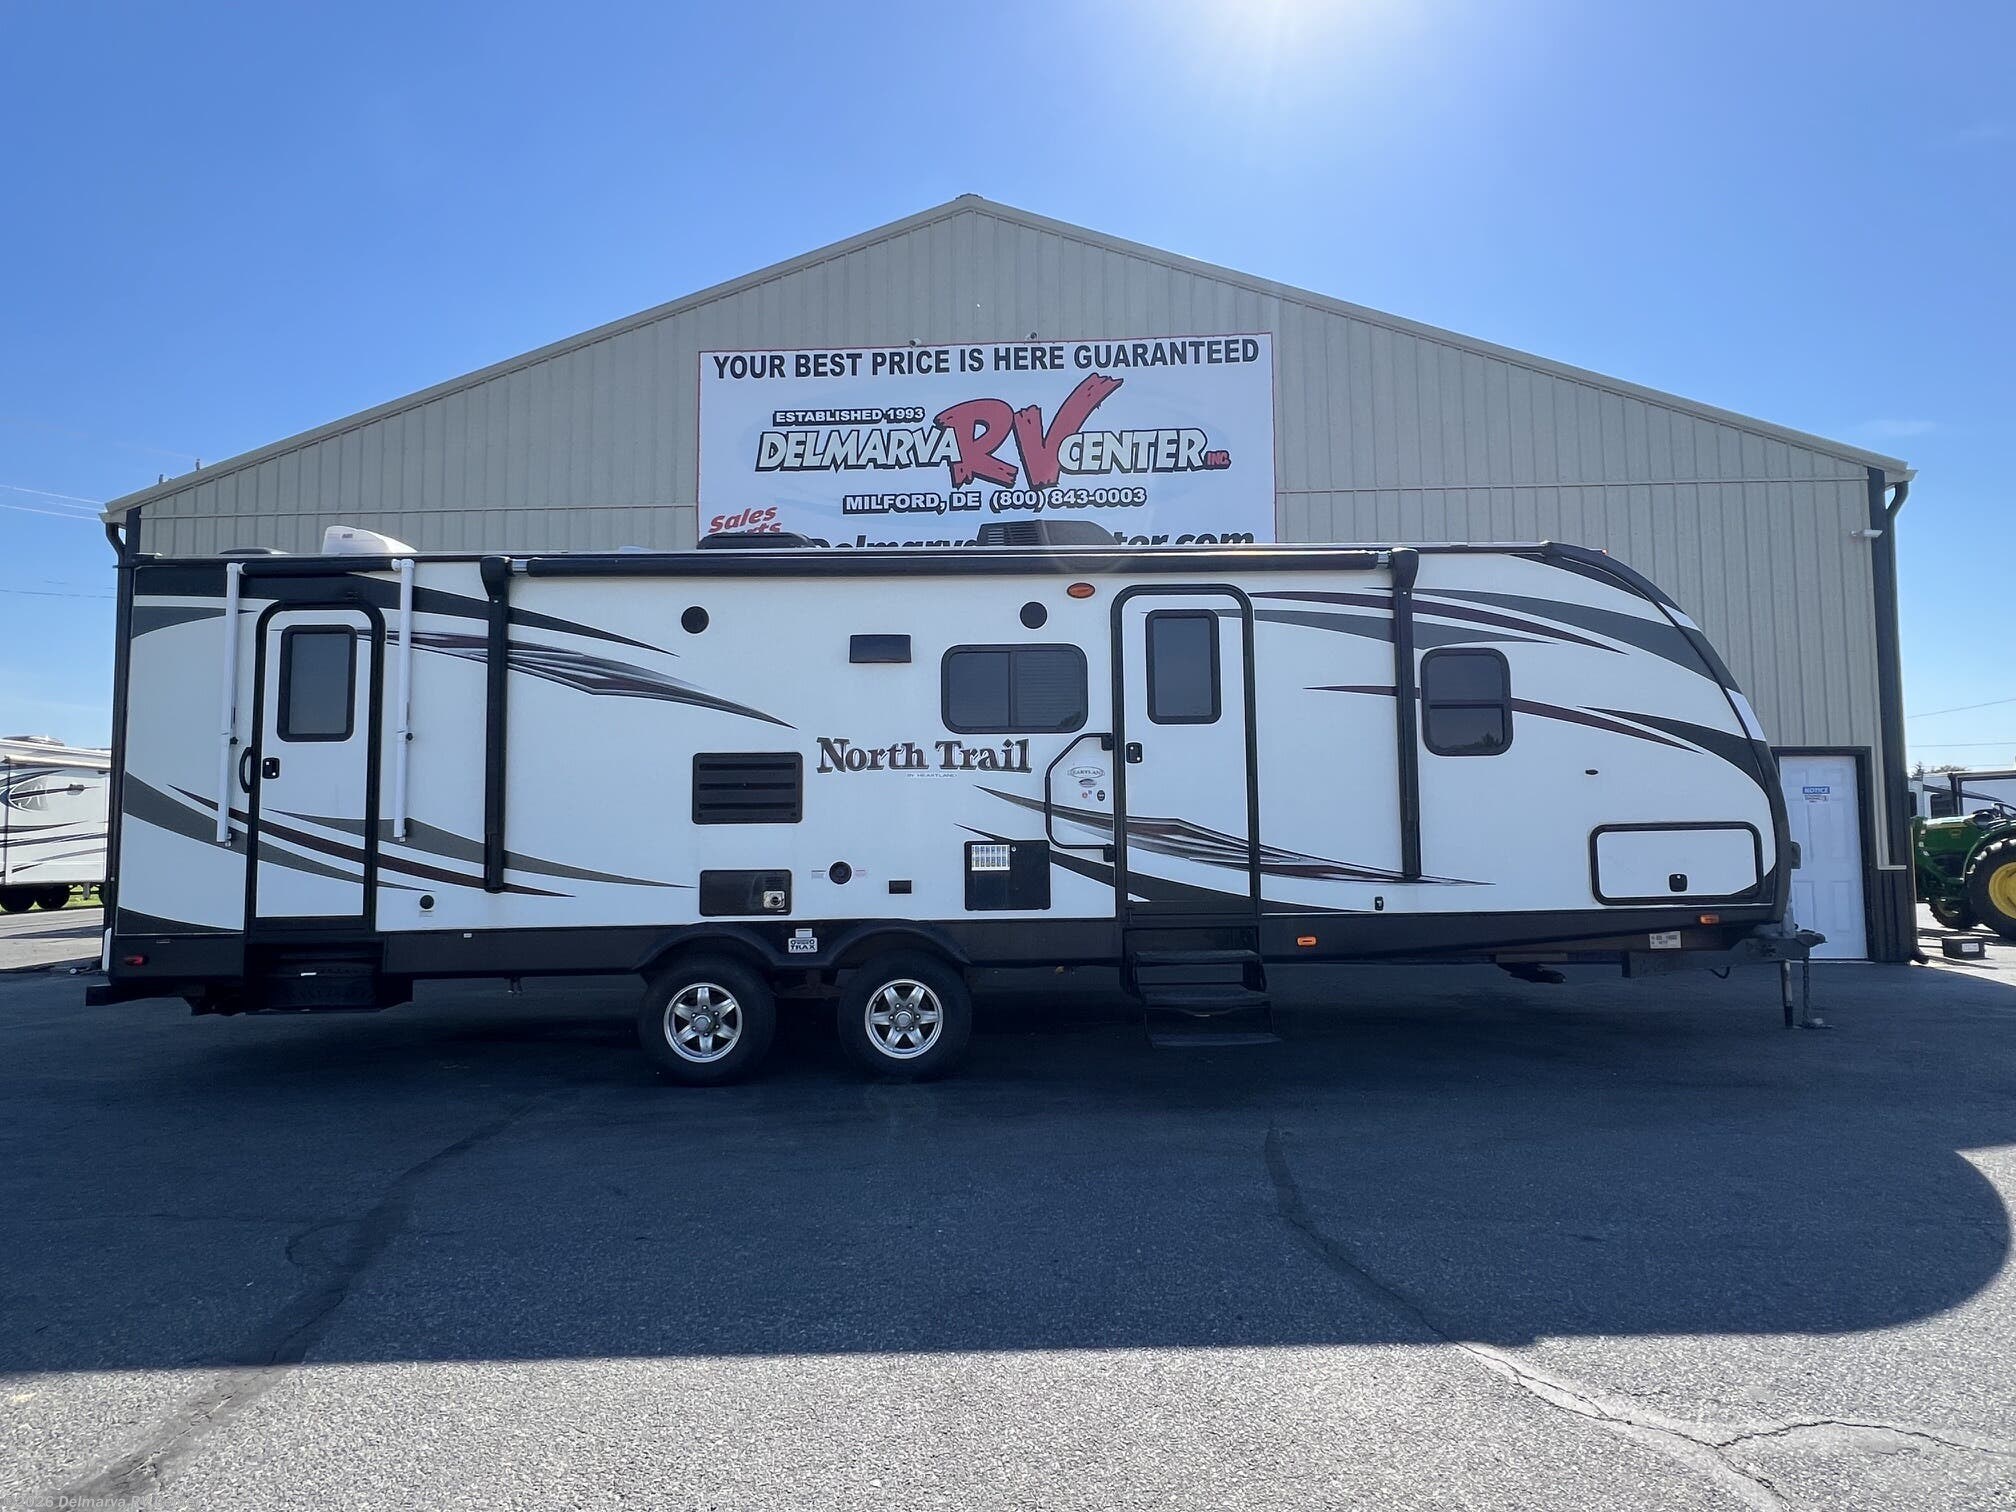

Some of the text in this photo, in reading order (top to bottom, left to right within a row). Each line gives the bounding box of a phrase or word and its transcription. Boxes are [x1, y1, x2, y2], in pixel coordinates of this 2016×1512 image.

[713, 338, 1259, 379] YOUR BEST PRICE IS HERE GUARANTEED
[756, 426, 962, 472] DELMARVA
[933, 373, 1124, 490] RV
[1058, 429, 1208, 474] CENTER
[774, 407, 925, 425] ESTABLISHED 1993
[843, 487, 1147, 514] MILFORD, DE (800) 843-0003
[708, 506, 778, 533] Sales
[816, 736, 1033, 774] North Trail
